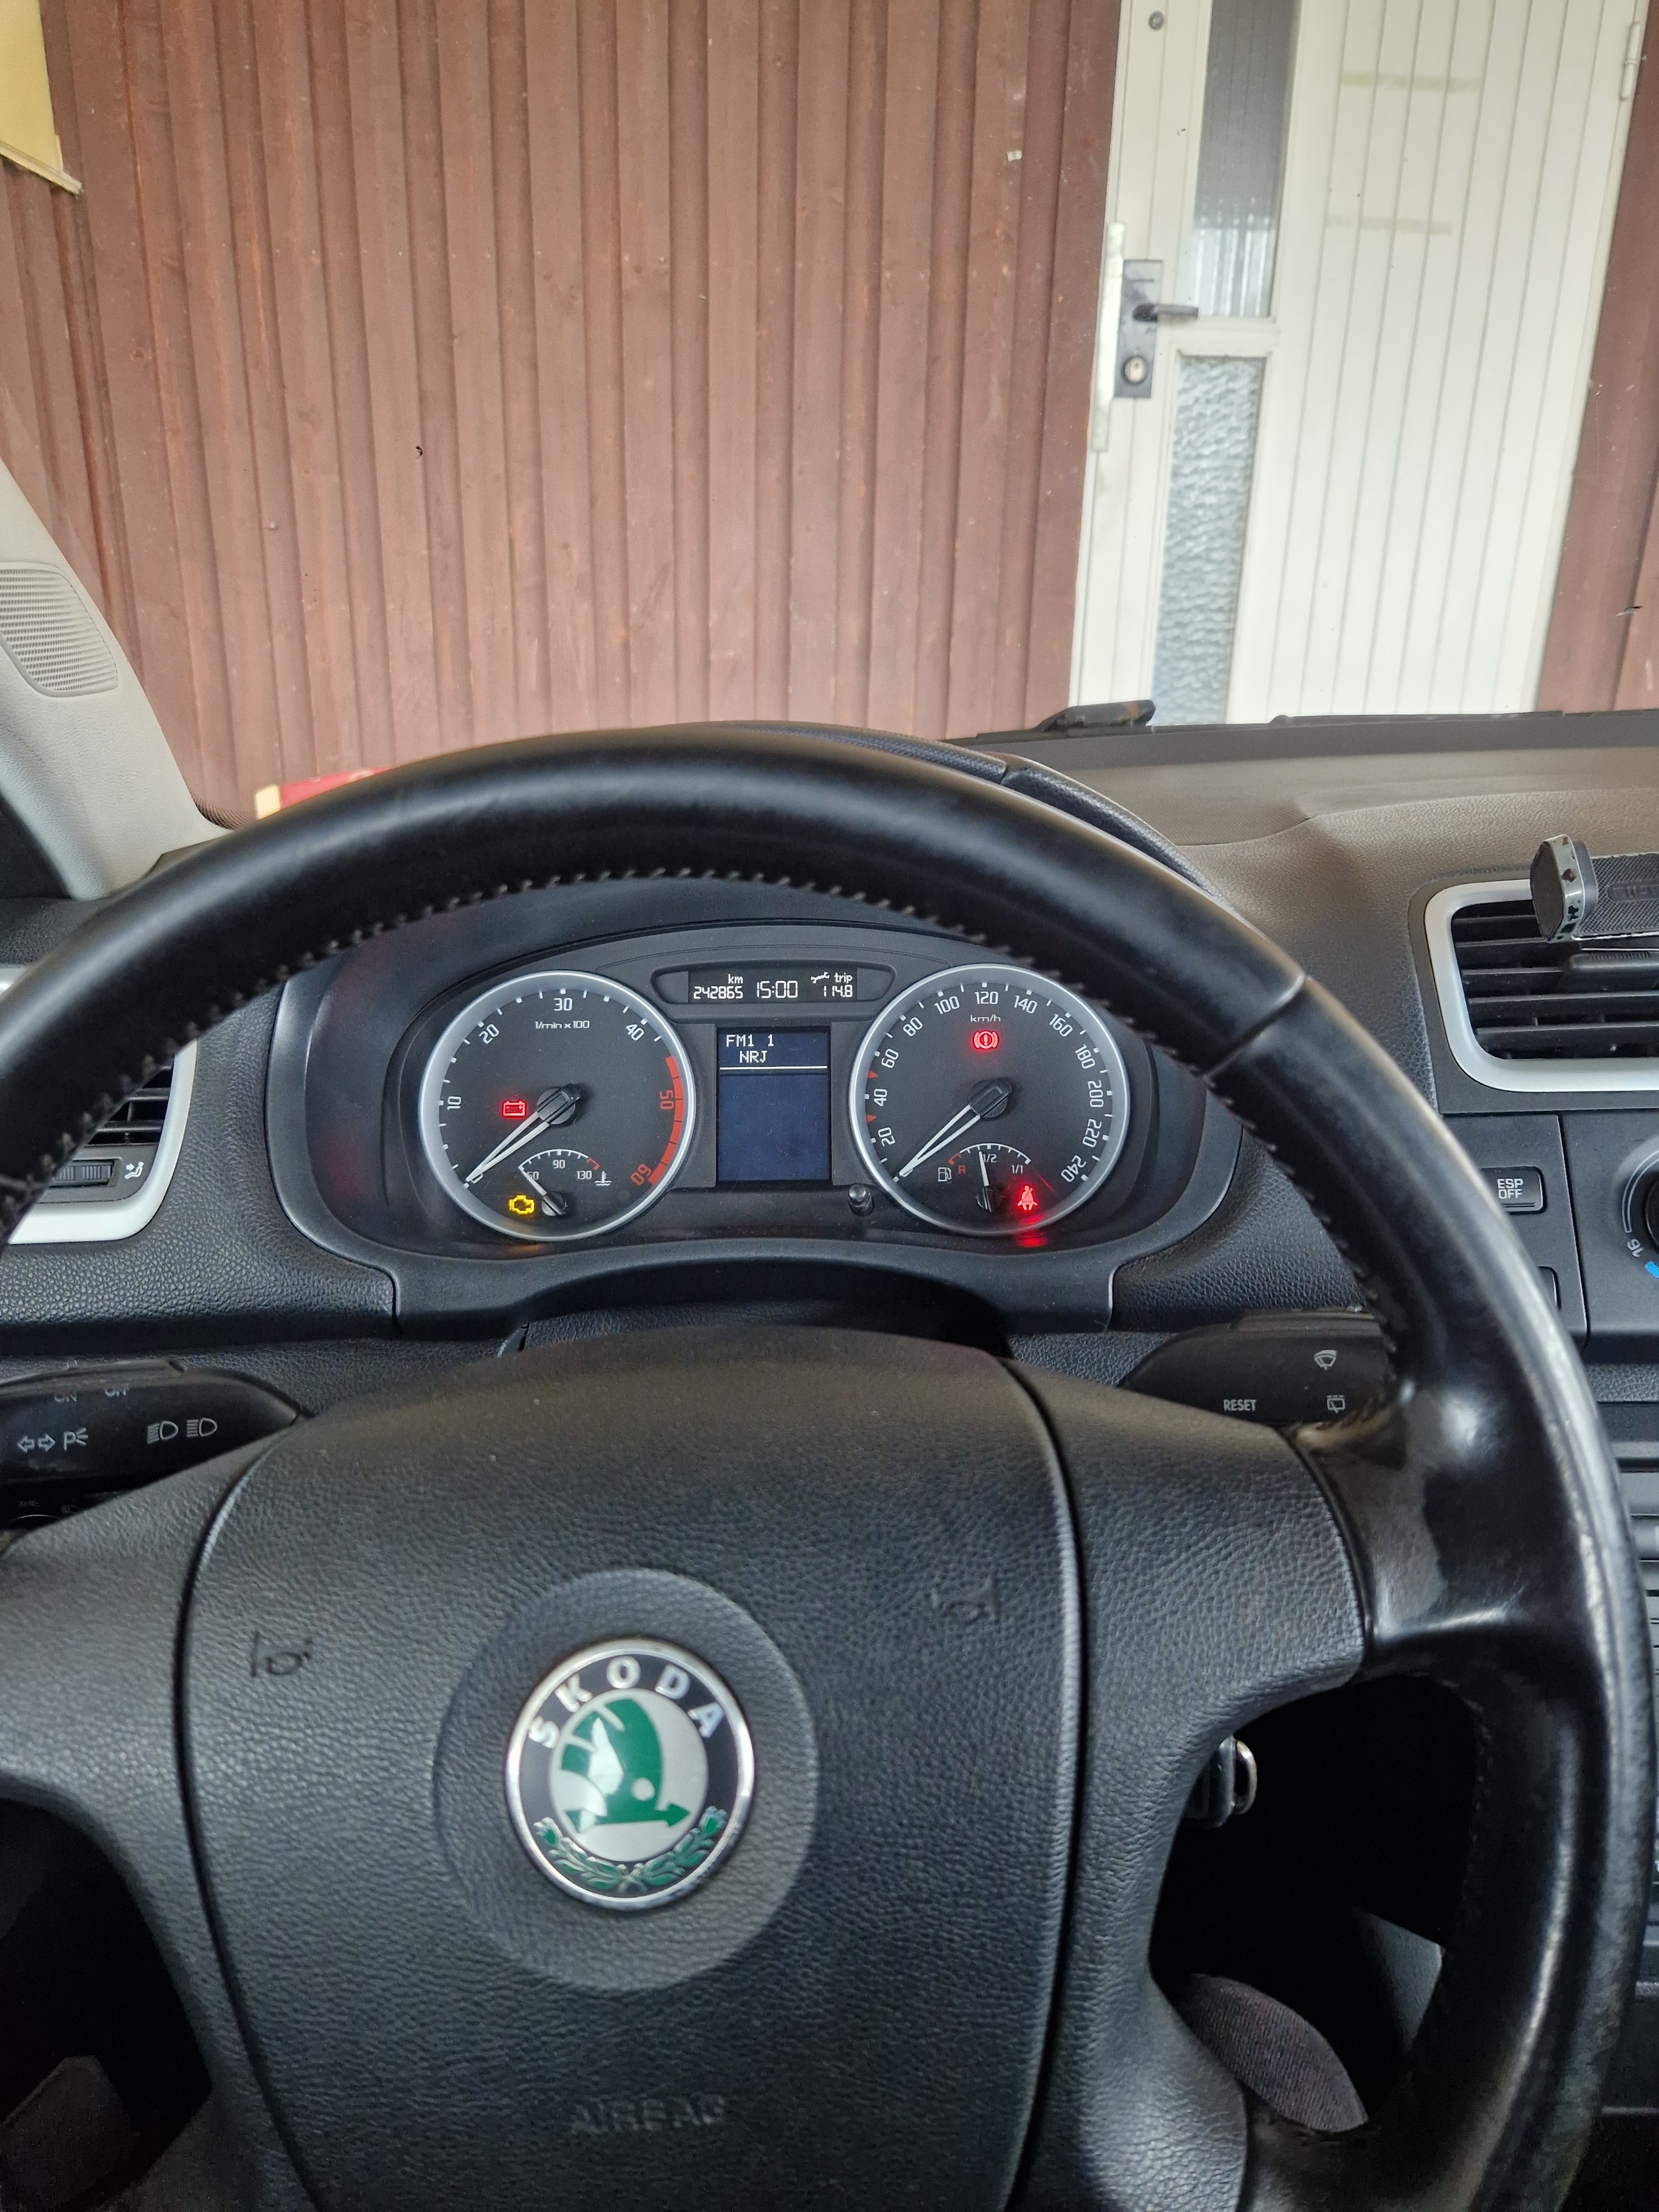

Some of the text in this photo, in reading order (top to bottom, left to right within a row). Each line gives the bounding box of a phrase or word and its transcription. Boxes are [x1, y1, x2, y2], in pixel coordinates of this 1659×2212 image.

[728, 974, 743, 984] km
[834, 972, 853, 984] trip
[693, 986, 743, 1000] 242865
[757, 980, 798, 998] 15:00
[554, 998, 572, 1011] 30
[934, 995, 959, 1015] 100
[974, 992, 998, 1005] 120
[1014, 995, 1037, 1014] 140
[535, 1021, 562, 1029] 1/min
[573, 1020, 590, 1029] 100
[625, 1023, 645, 1041] 40
[902, 1018, 924, 1037] 80
[1048, 1014, 1073, 1037] 160
[479, 1023, 500, 1045] 20
[726, 1034, 774, 1047] FM1 1
[739, 1050, 767, 1063] NRJ
[881, 1048, 899, 1068] 60
[1074, 1044, 1095, 1070] 180
[447, 1095, 461, 1110] 10
[660, 1089, 674, 1110] 50
[874, 1088, 888, 1107] 40
[1087, 1080, 1104, 1108] 200
[878, 1127, 896, 1146] 20
[1082, 1118, 1102, 1147] 220
[553, 1160, 566, 1169] 90
[1061, 1155, 1087, 1183] 240
[576, 1170, 592, 1180] 130
[630, 1164, 652, 1186] 60
[1497, 1178, 1524, 1188] ESP
[1498, 1189, 1523, 1199] OFF
[1223, 1399, 1257, 1411] RESET
